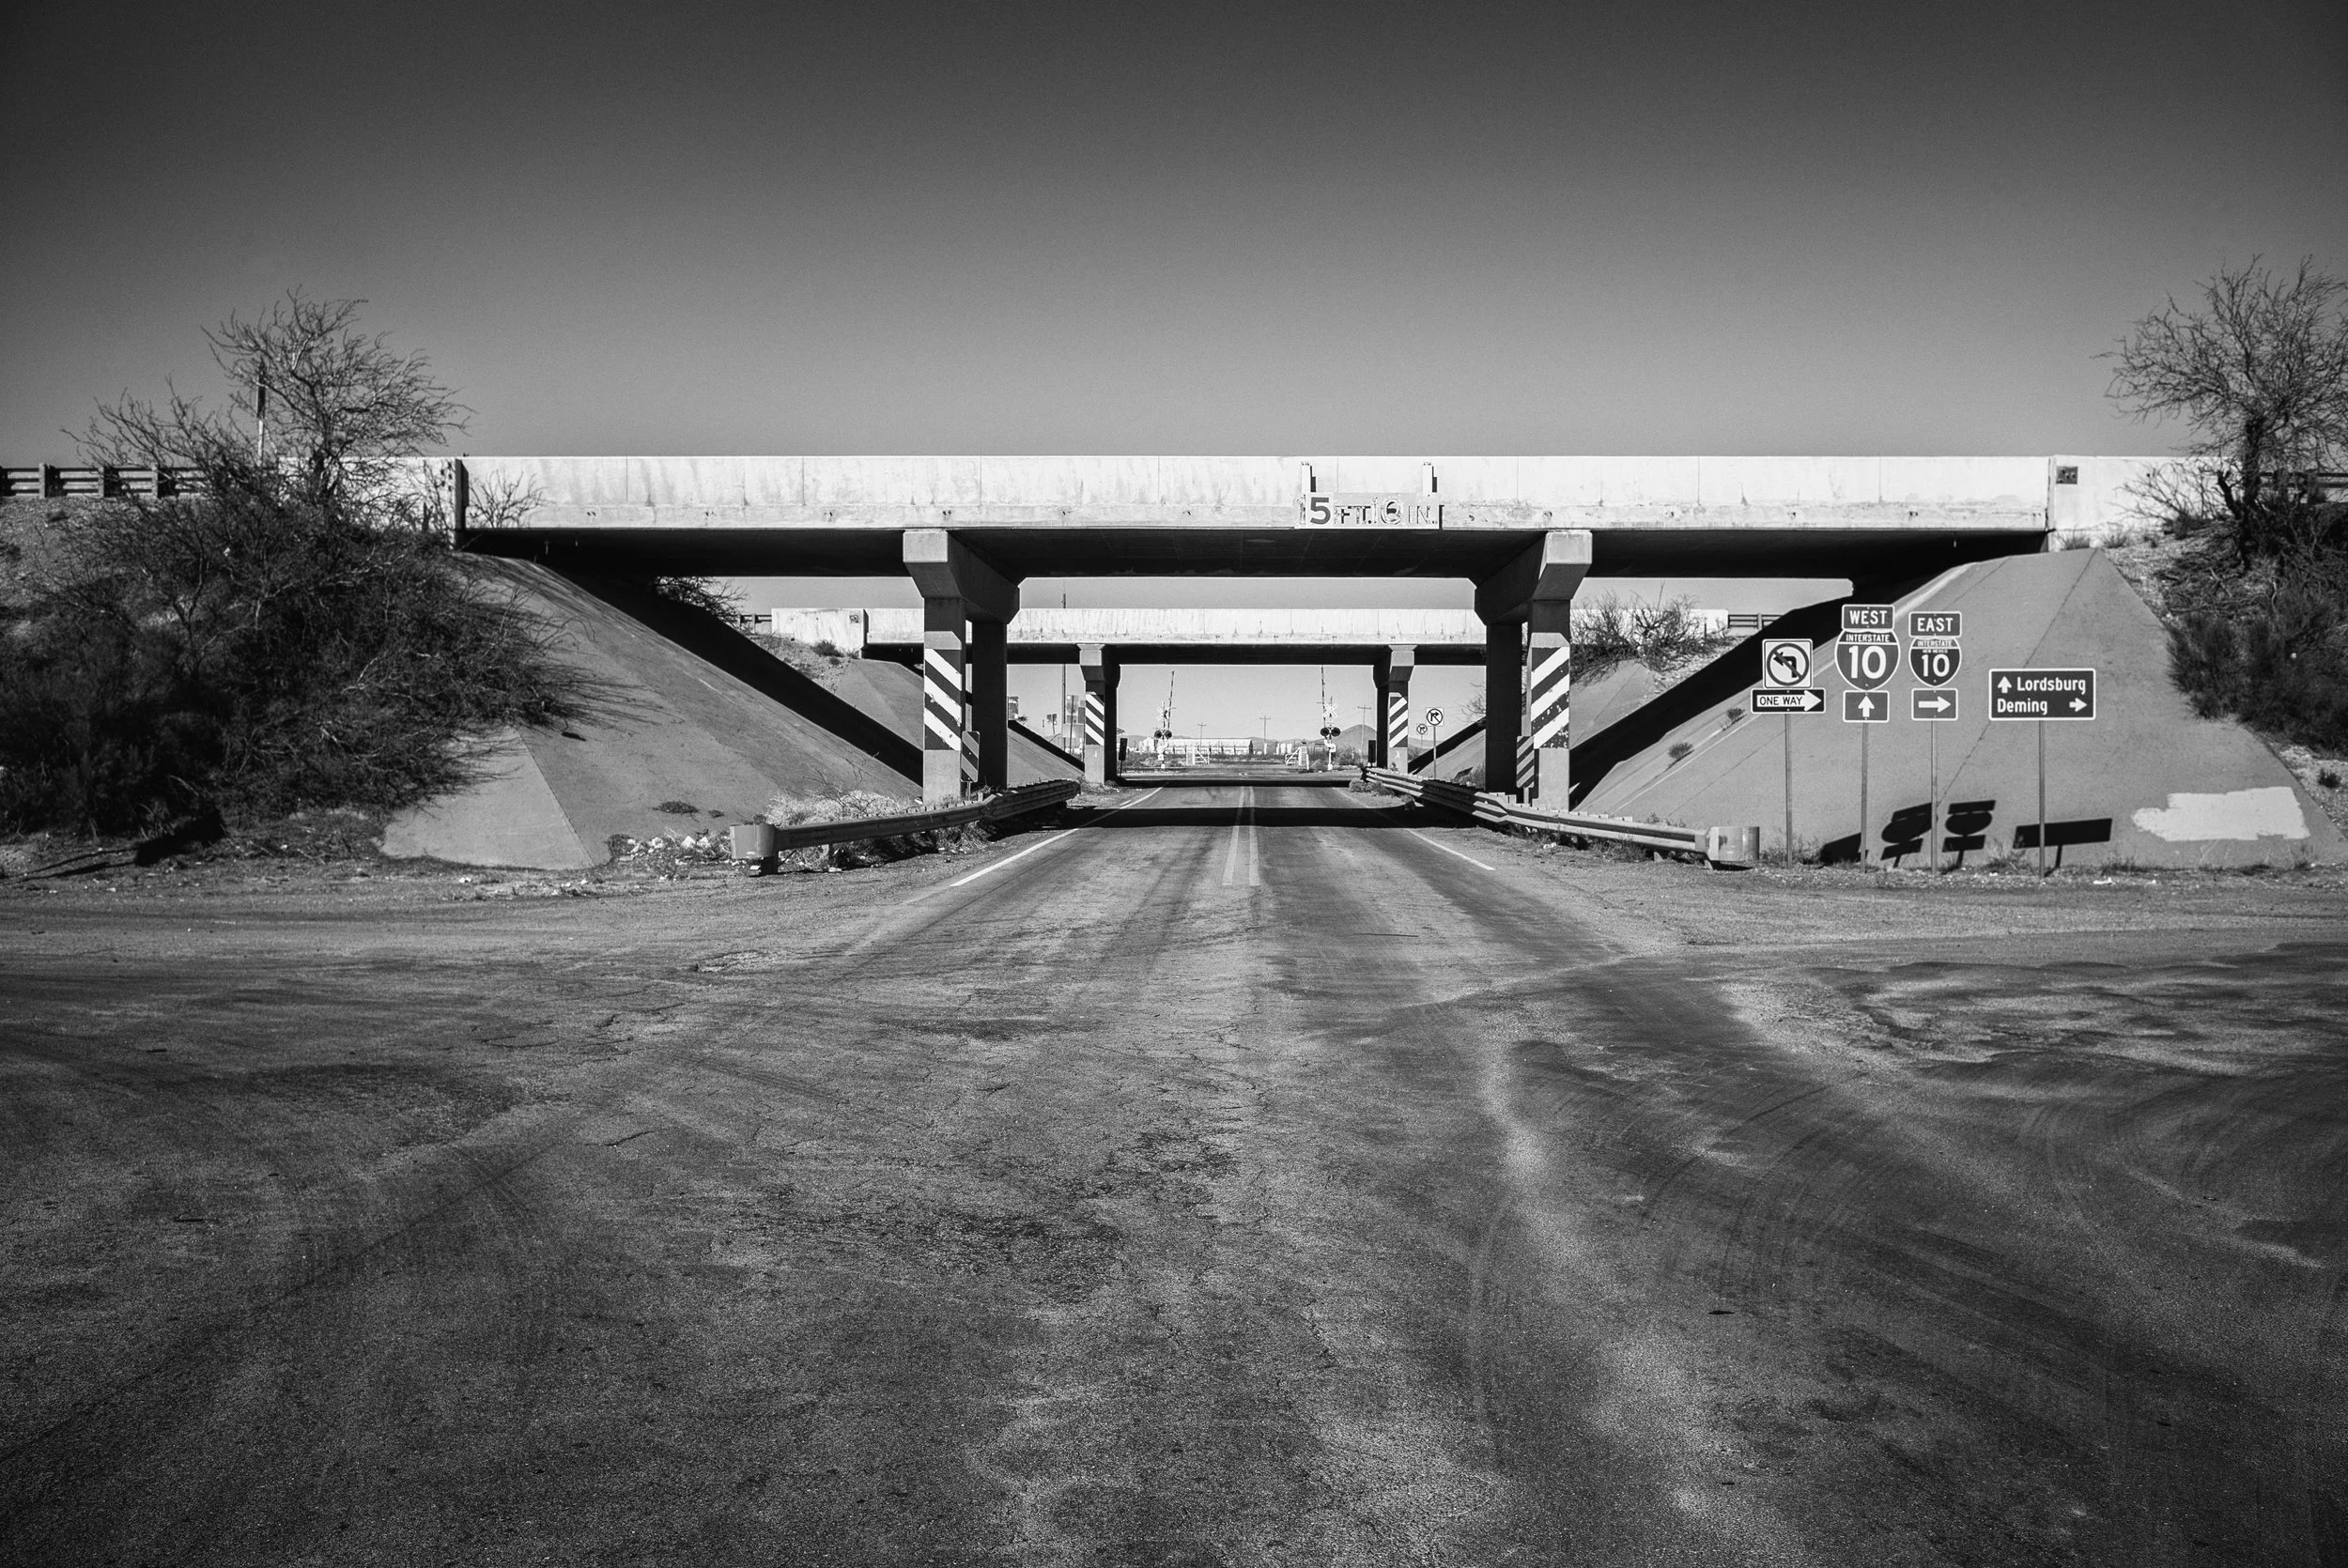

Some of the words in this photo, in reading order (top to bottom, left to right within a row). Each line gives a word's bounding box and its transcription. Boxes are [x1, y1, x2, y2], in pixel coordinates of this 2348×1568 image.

[1848, 609, 1888, 625] WEST
[1917, 617, 1954, 633] EAST
[1846, 633, 1891, 643] INTERSTATE
[1847, 645, 1888, 680] 10
[1921, 653, 1951, 677] 10
[2016, 676, 2086, 696] Lordsburg
[1759, 696, 1780, 706] ONE
[1782, 696, 1803, 706] WAY
[1997, 698, 2048, 715] Deming
